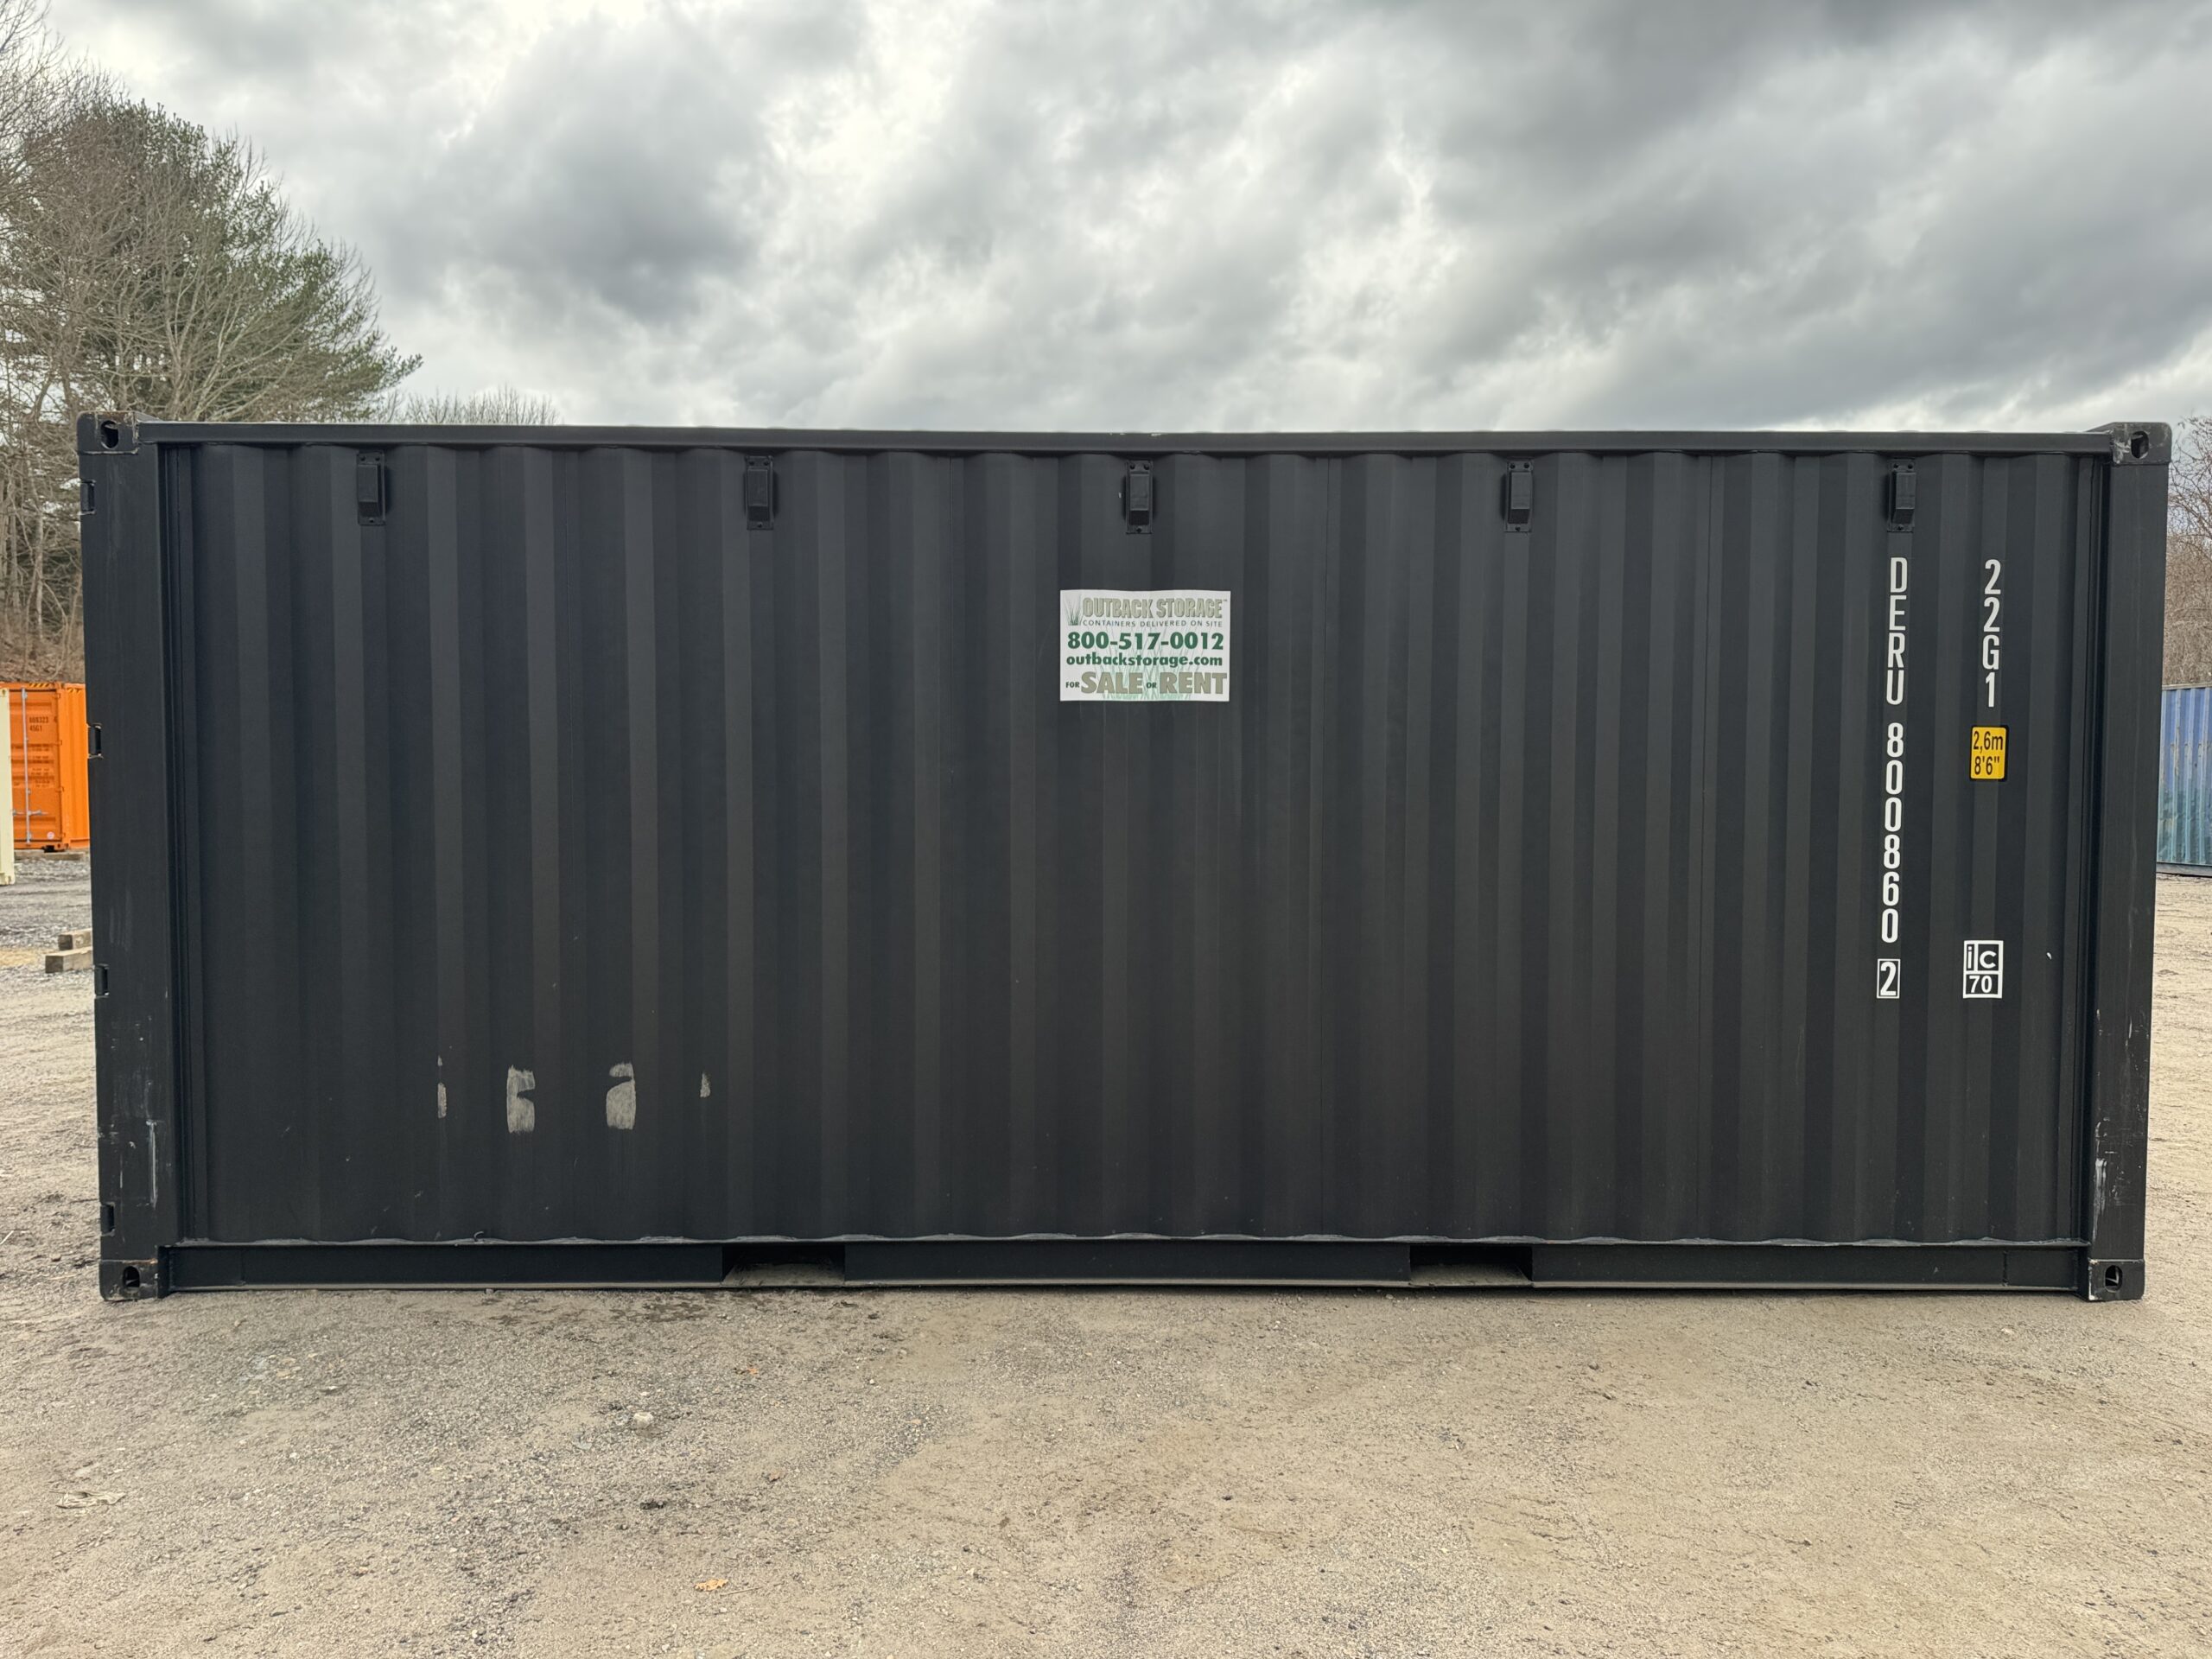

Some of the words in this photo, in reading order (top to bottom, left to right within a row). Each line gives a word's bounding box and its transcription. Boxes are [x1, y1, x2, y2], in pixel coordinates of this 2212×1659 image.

[1083, 597, 1153, 618] OUTBACK
[1156, 598, 1223, 618] STORAGE
[1067, 632, 1224, 650] 800-517-0012
[1886, 556, 1908, 705] DERU
[1982, 559, 2001, 708] 22G1
[1066, 652, 1223, 668] outbackstorage.com
[1081, 671, 1143, 694] SALE
[1160, 671, 1227, 694] RENT
[1973, 731, 2004, 753] 2,6m
[1881, 722, 1904, 943] 800860
[1879, 961, 1897, 996] 2
[1968, 975, 1993, 994] 70
